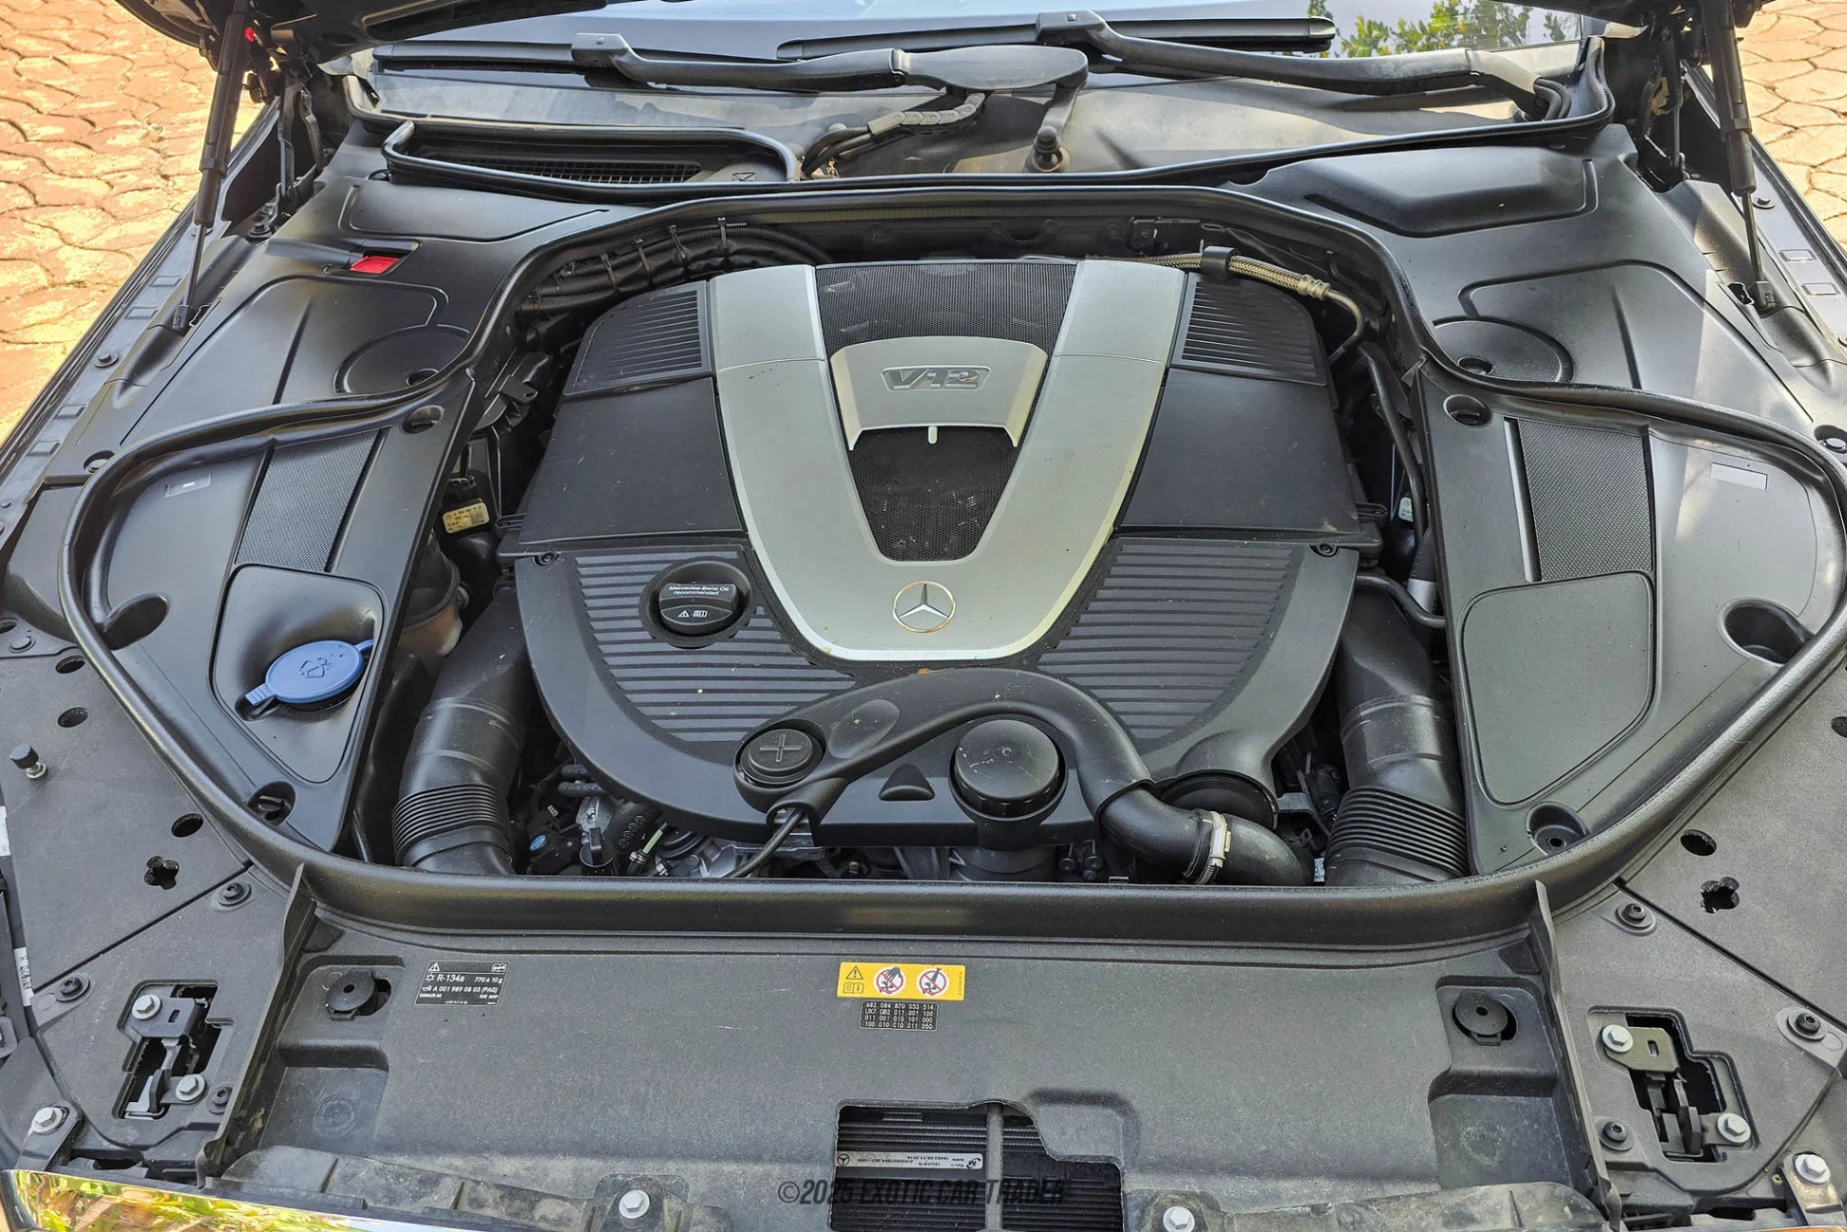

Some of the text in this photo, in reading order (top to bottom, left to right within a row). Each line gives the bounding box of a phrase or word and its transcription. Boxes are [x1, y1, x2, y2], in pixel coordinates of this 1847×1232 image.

[890, 368, 980, 389] V12
[436, 974, 465, 983] R-134a
[481, 986, 498, 994] (PAG)
